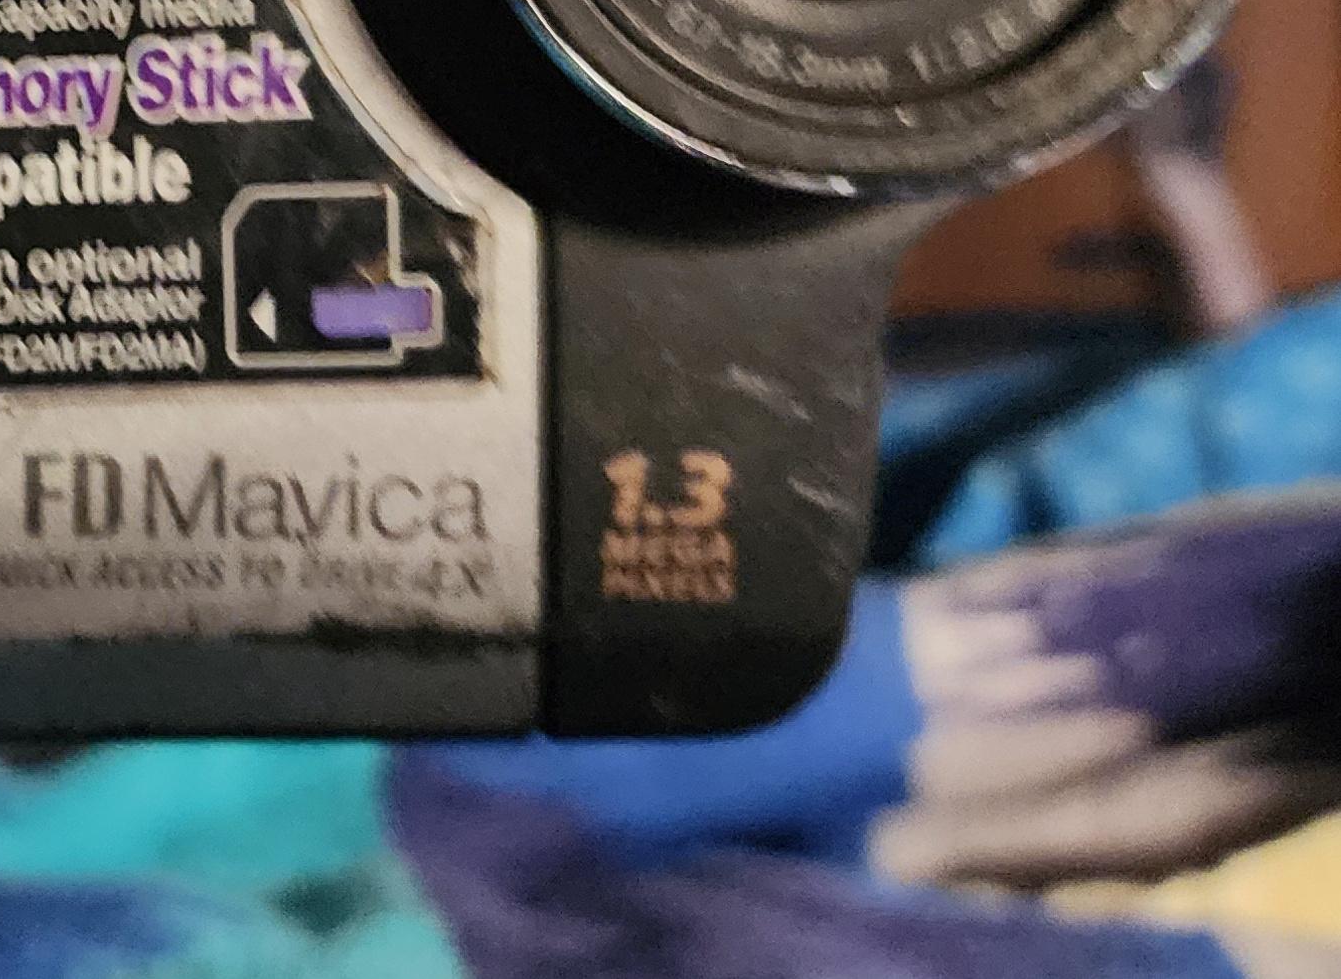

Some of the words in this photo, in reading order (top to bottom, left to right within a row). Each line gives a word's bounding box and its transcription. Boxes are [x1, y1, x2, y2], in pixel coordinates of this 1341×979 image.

[129, 36, 309, 120] Stick
[26, 238, 202, 293] optional
[22, 451, 124, 540] FD
[143, 449, 496, 542] Mavica
[602, 449, 734, 527] 1.3
